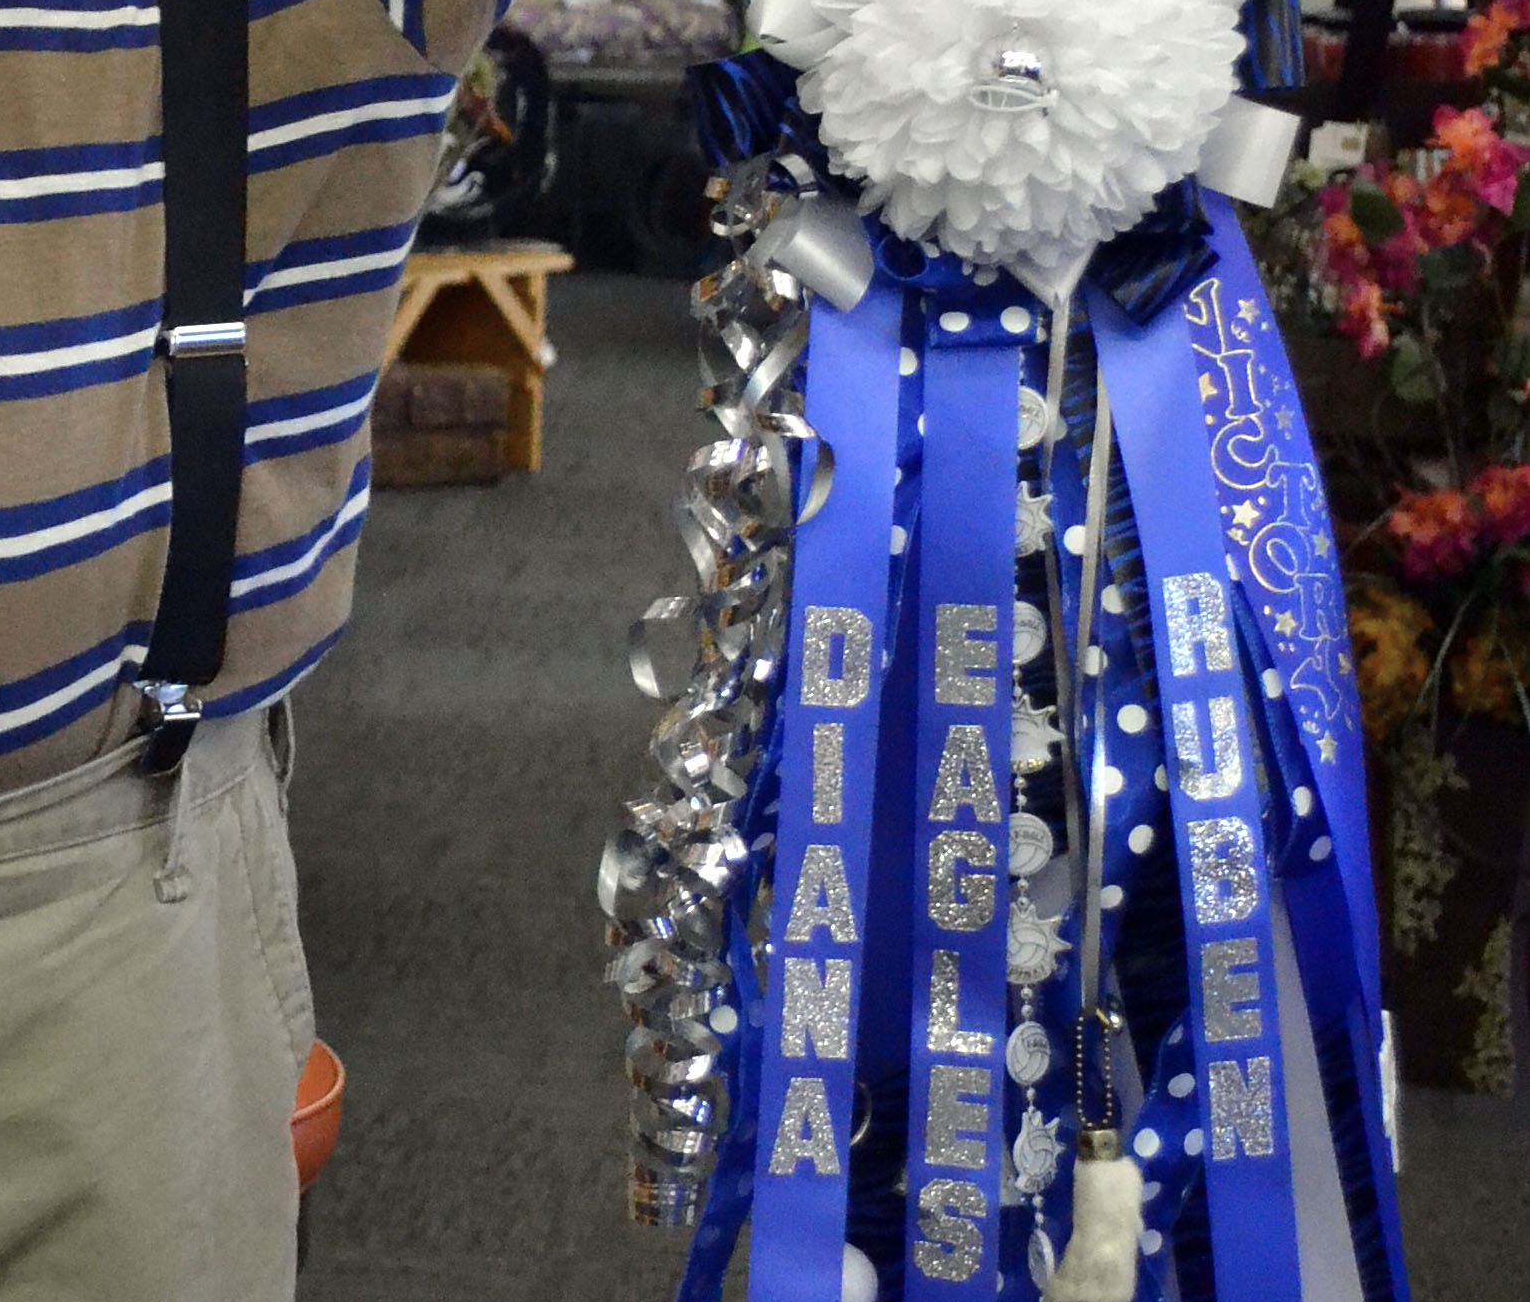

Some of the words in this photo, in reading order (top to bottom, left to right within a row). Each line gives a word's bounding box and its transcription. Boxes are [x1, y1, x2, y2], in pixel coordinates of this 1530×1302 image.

[769, 605, 873, 1176] DIANA
[913, 603, 1002, 1283] EAGLES
[1162, 571, 1276, 1162] RUBEN
